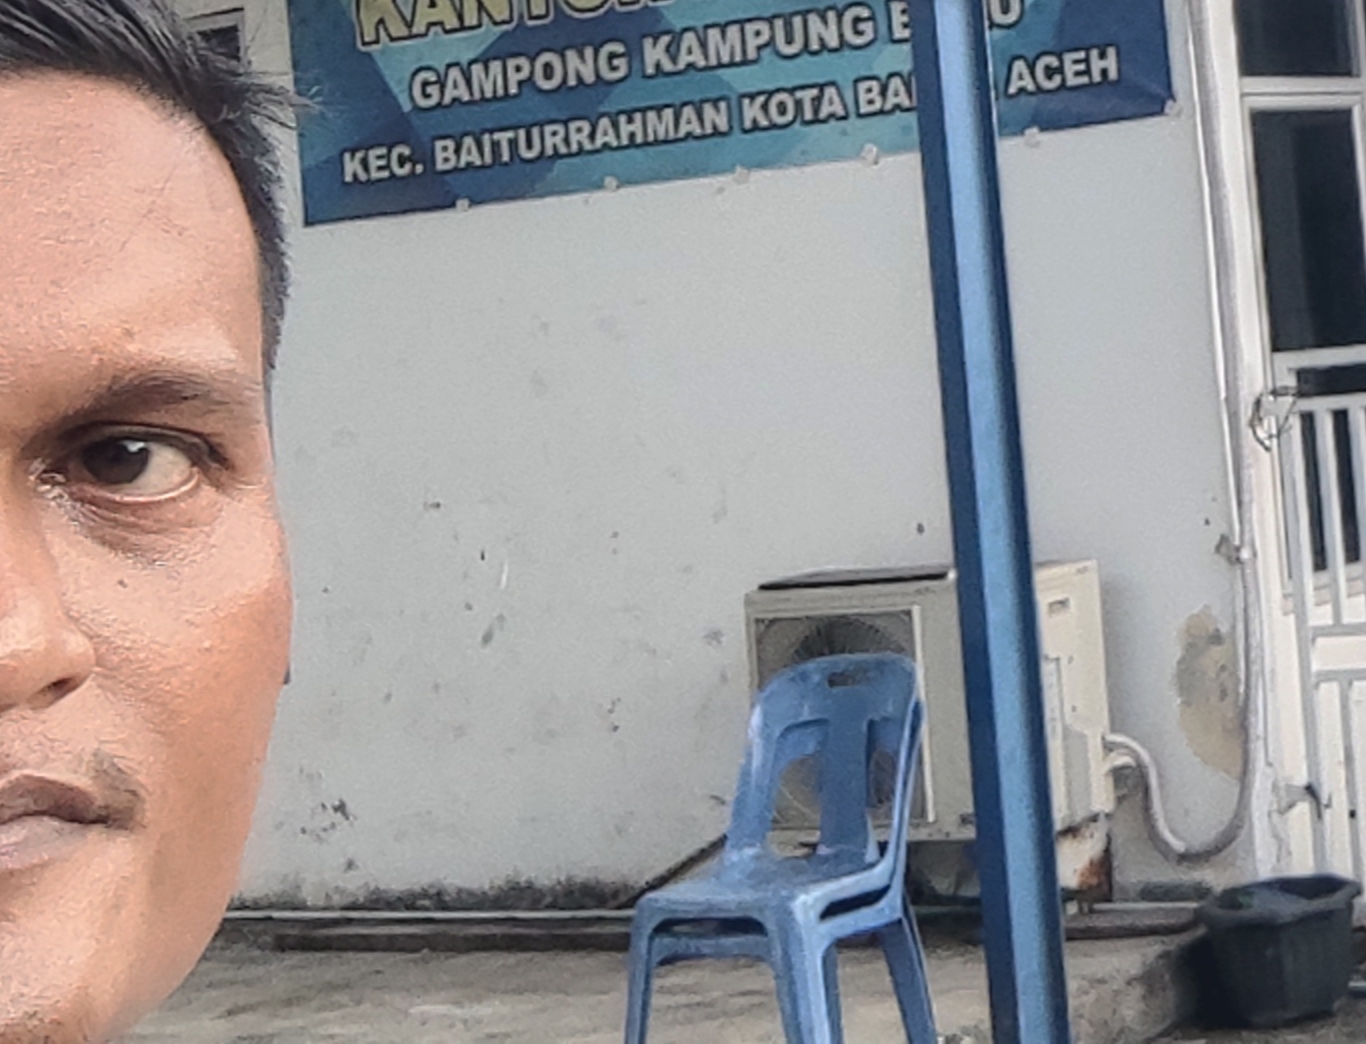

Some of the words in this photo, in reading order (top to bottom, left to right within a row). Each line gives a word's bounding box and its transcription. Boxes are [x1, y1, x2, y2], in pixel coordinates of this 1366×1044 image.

[342, 144, 425, 184] KEC.
[434, 98, 730, 173] BAITURRAHMAN
[741, 84, 847, 134] KOTA
[1006, 46, 1120, 96] ACEH
[410, 40, 631, 109] GAMPONG
[641, 1, 876, 77] KAMPUNG
